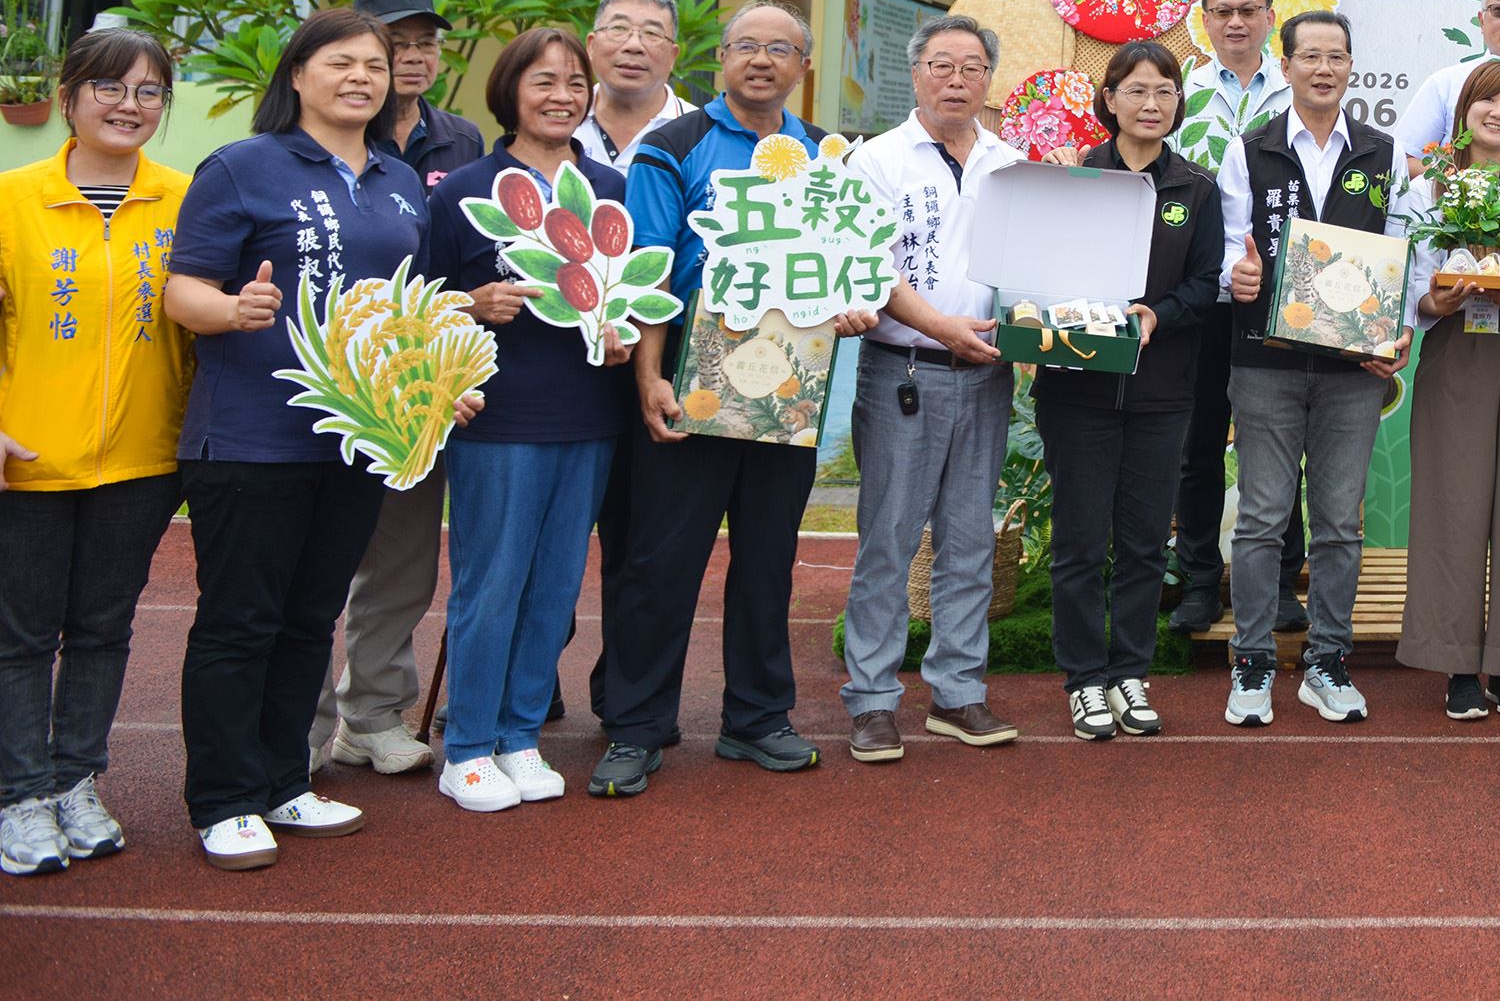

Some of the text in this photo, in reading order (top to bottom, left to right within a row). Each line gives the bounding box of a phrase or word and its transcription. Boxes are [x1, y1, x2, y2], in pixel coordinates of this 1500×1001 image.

[1348, 72, 1409, 90] 2026
[715, 165, 872, 247] 五穀
[902, 194, 915, 223] 主席
[923, 186, 941, 290] 銅鑼鄉民代表會
[50, 247, 79, 340] 謝芳怡
[710, 252, 894, 311] 好日仔
